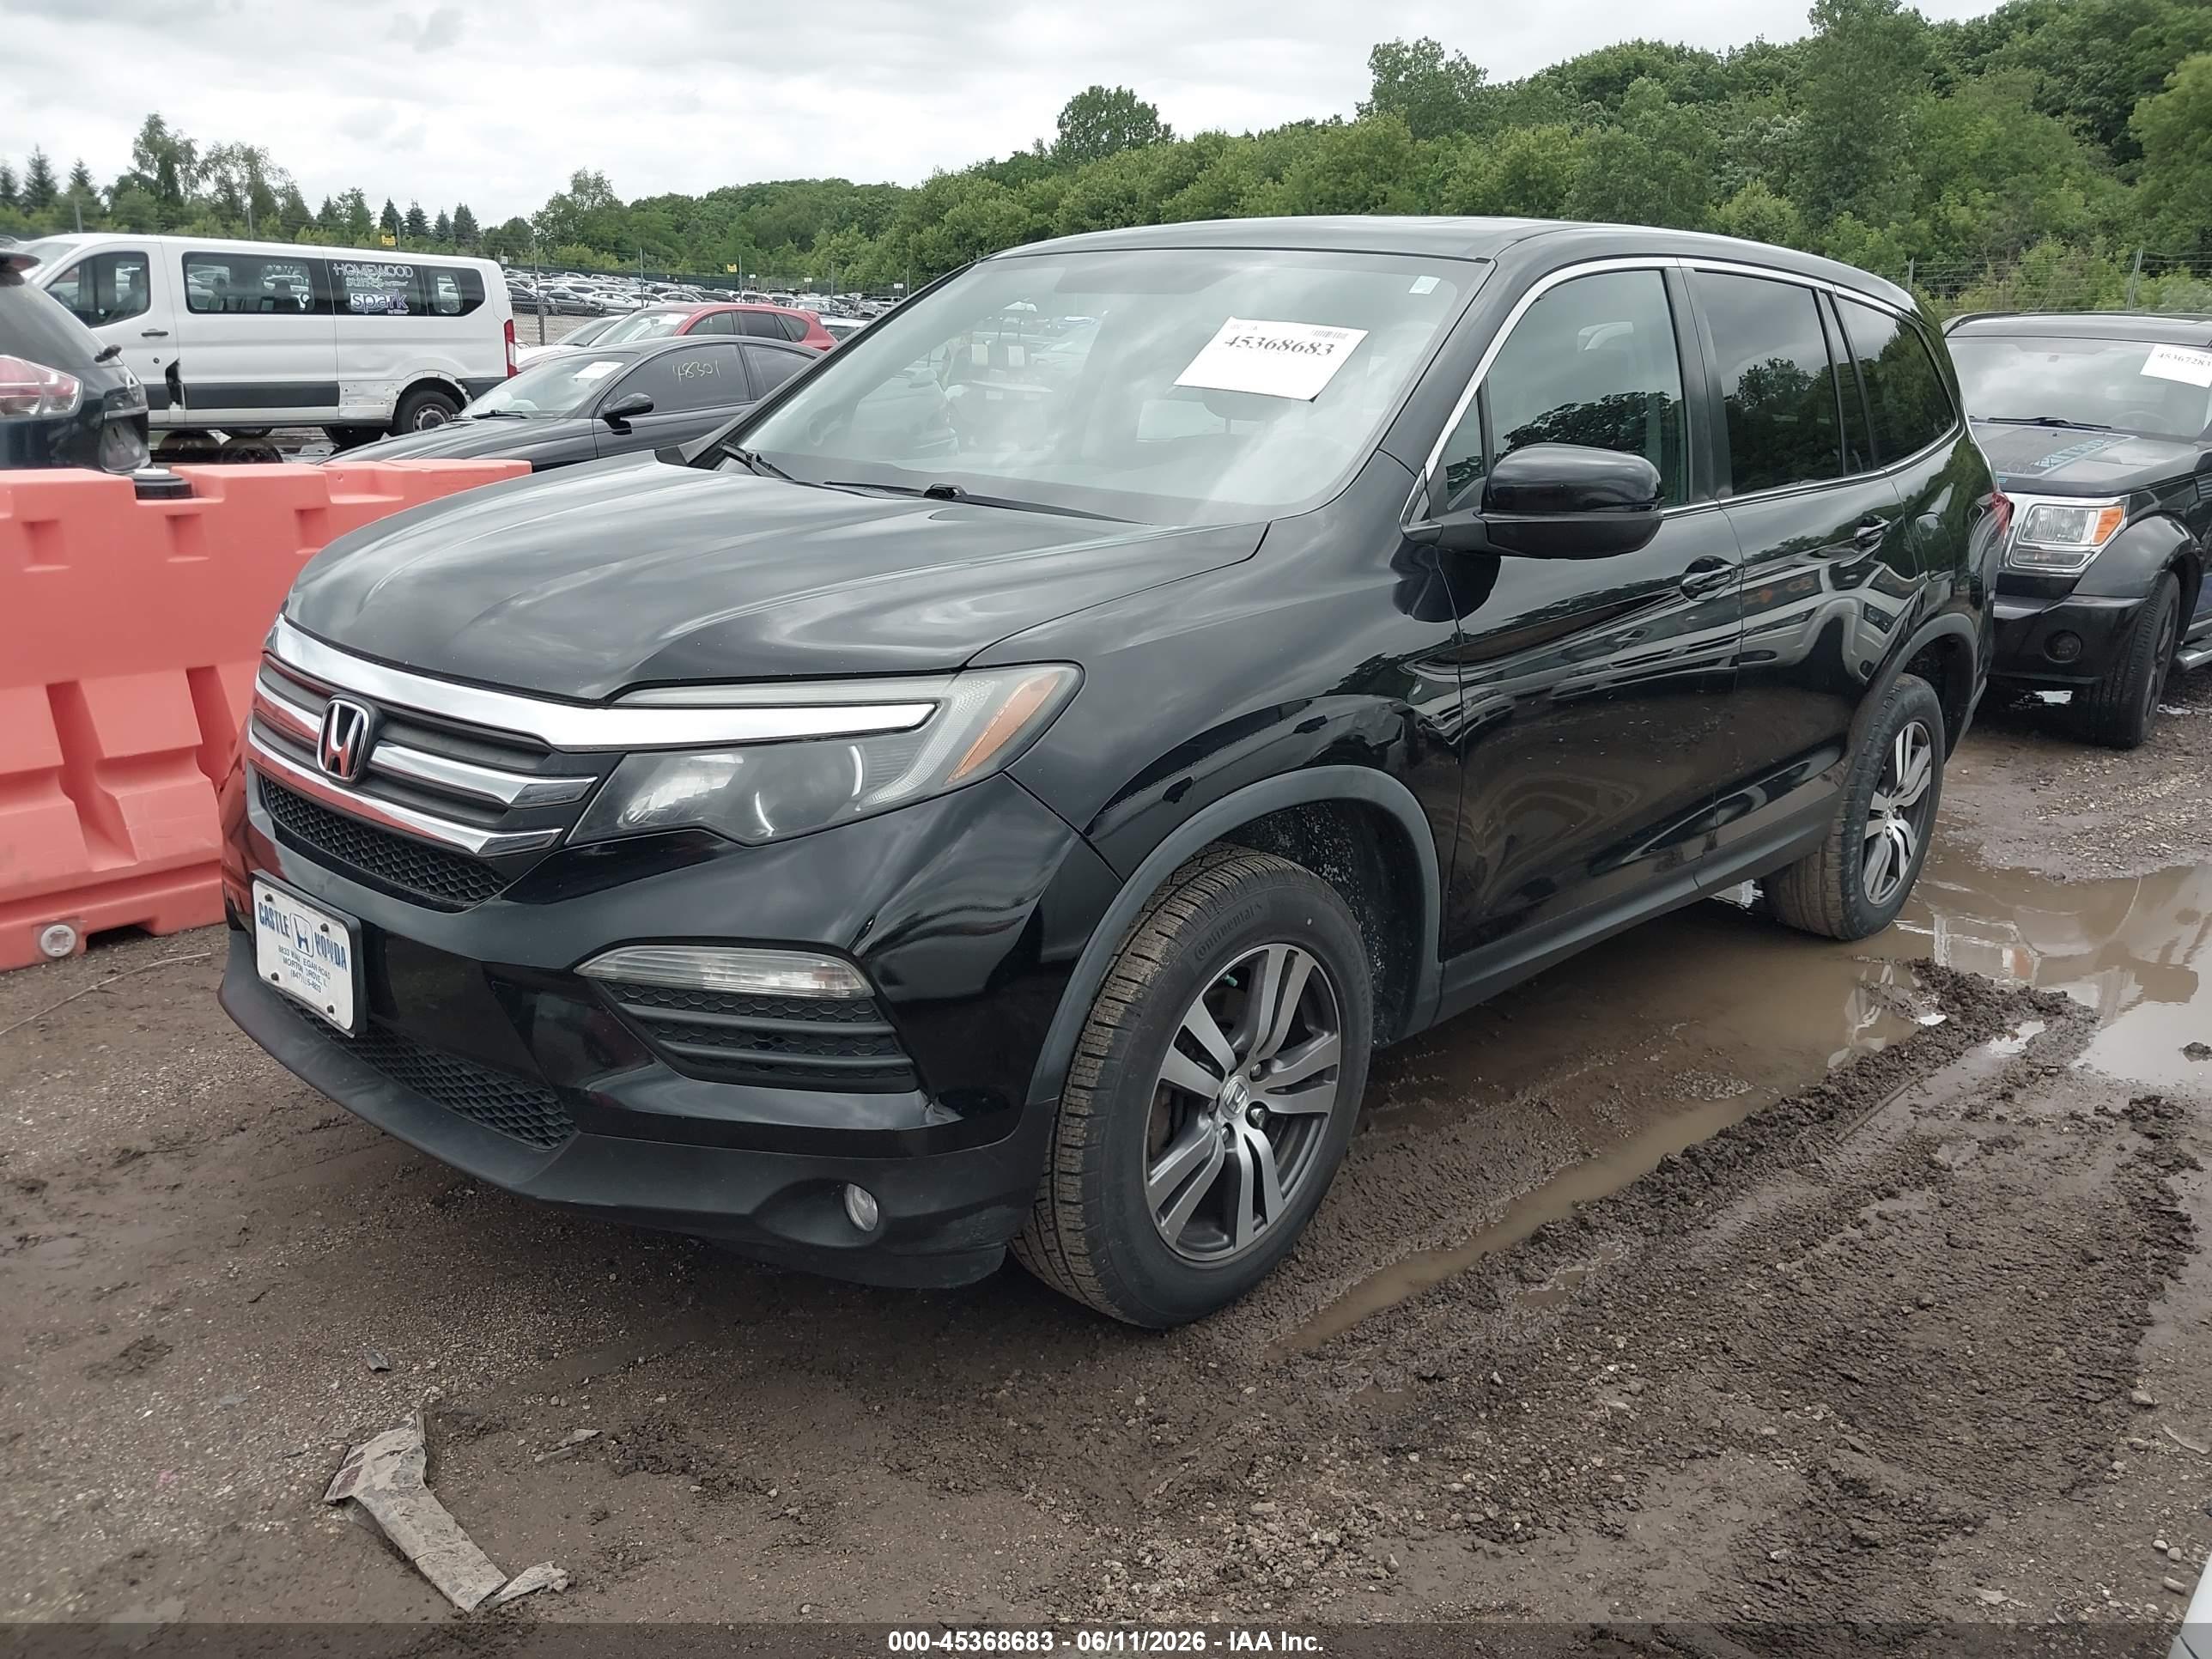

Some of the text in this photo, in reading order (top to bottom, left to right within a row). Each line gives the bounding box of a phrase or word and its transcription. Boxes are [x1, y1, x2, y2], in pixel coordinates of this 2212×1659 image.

[333, 263, 414, 278] HOMEWOOD
[345, 276, 385, 288] SUITES
[351, 289, 410, 314] spark
[1224, 334, 1335, 356] 45368683
[258, 901, 290, 939] CASTLE
[314, 931, 348, 972] HONDA
[283, 956, 304, 974] MORTON
[290, 950, 318, 969] WAUEGAN
[318, 965, 331, 981] ROAD
